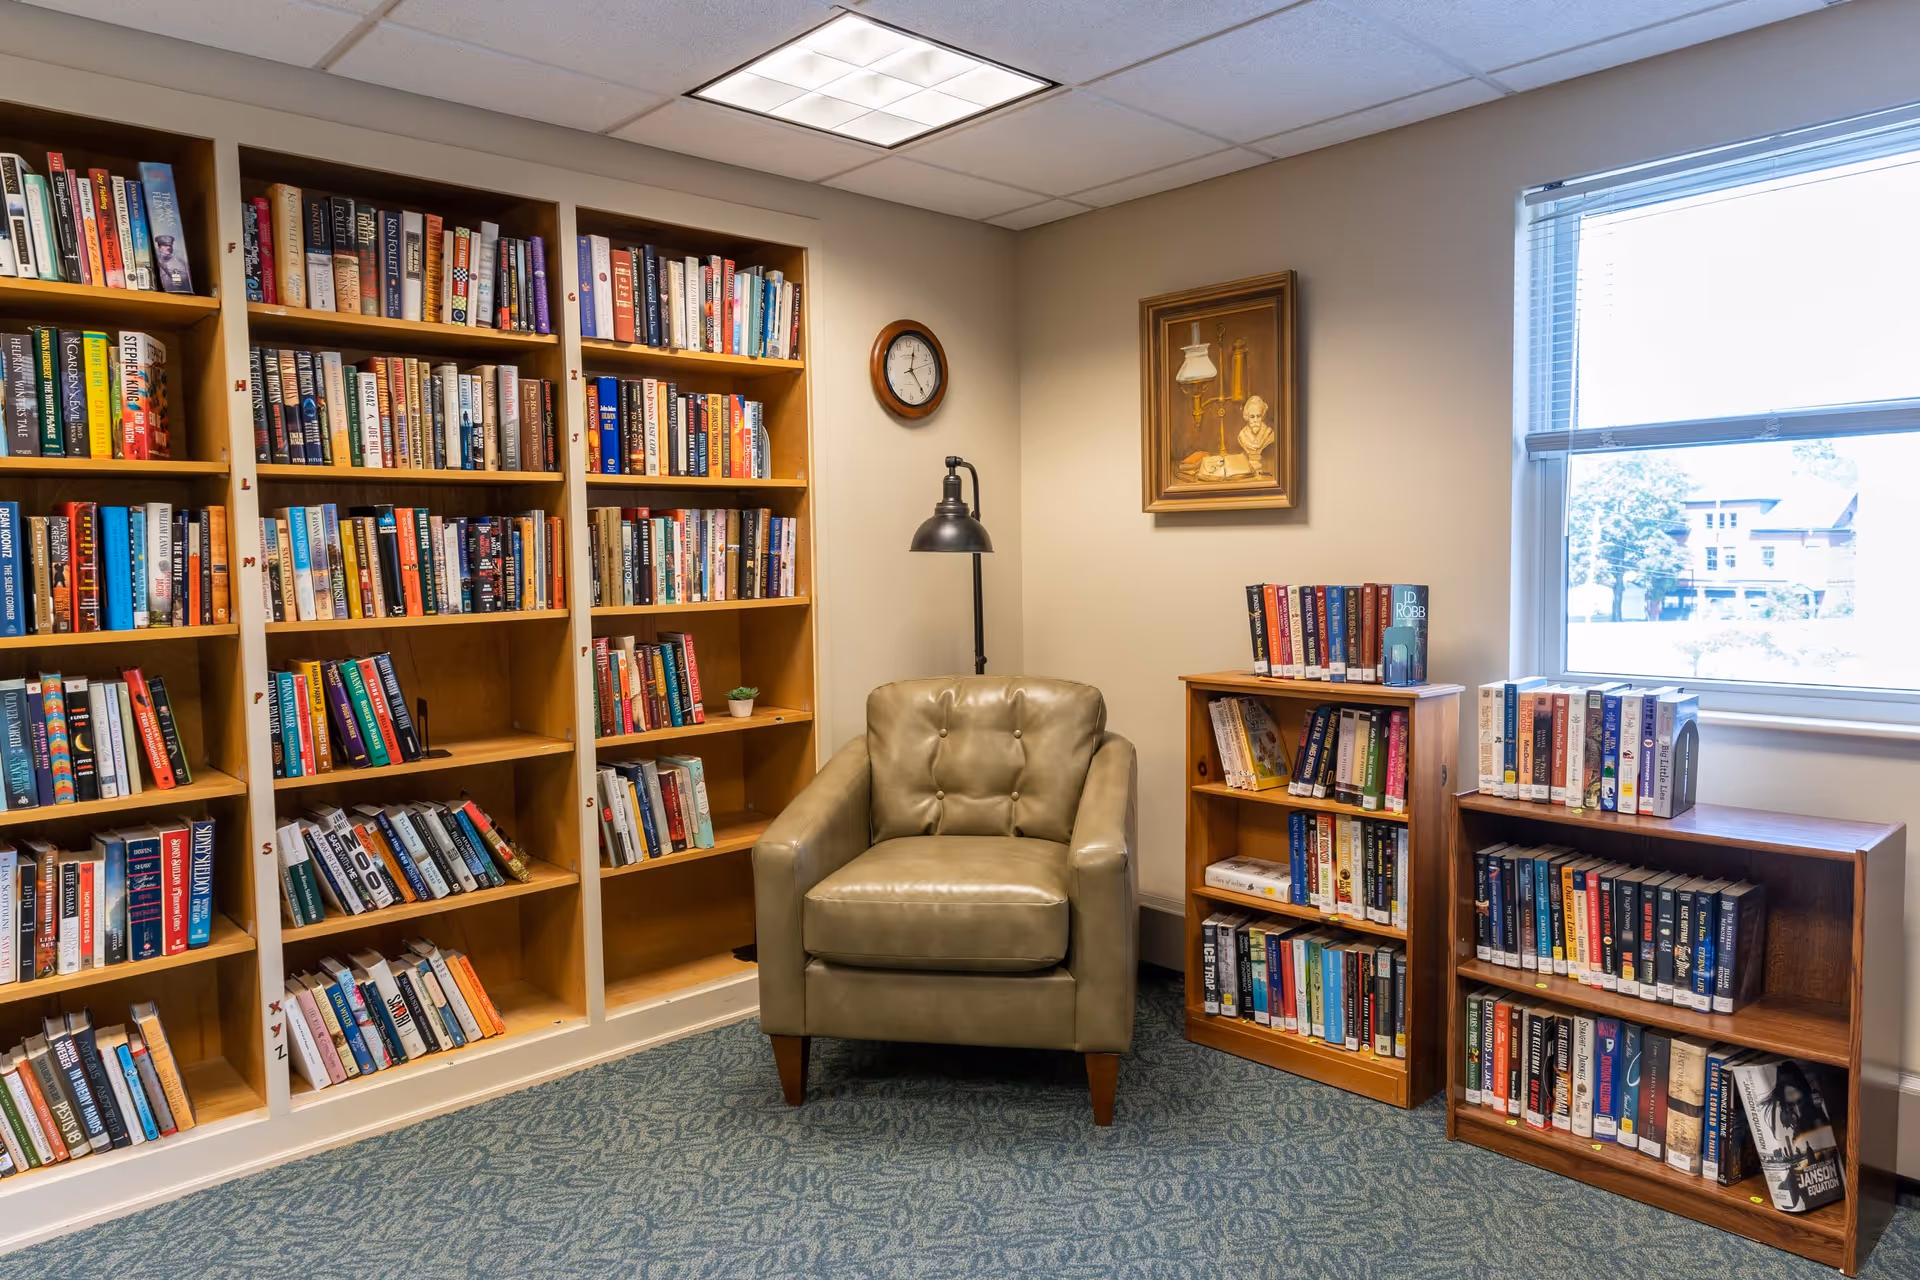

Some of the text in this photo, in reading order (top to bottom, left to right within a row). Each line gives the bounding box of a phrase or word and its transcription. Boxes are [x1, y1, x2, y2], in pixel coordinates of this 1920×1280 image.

[96, 173, 108, 210] Joy Fielding
[334, 204, 346, 245] FOLLETT
[357, 212, 370, 245] FOLLETT
[227, 242, 236, 253] F
[387, 218, 399, 275] KEN FOLLETT
[458, 238, 467, 268] FELIX FRANCIS
[338, 265, 349, 302] GIANTS
[568, 292, 576, 302] G
[40, 329, 52, 379] FRANK HERBERT
[896, 343, 902, 351] 11
[905, 340, 912, 348] 12
[924, 354, 928, 362] 2
[66, 344, 78, 388] GARDEN
[124, 335, 139, 402] STEPHEN KING
[265, 355, 281, 403] JACK HIGGINS
[297, 353, 314, 396] JACK HIGGINS
[571, 369, 578, 381] I
[927, 367, 932, 375] 3
[11, 338, 23, 373] HELPRIN
[17, 419, 28, 438] TALE
[235, 379, 247, 392] H
[364, 380, 375, 407] NOS4A2
[375, 361, 390, 416] TONY HILLERMAN
[69, 400, 81, 421] EVIL
[134, 412, 144, 435] END OF
[711, 397, 719, 431] IRIS JOHANSEN
[368, 425, 379, 455] JOE HILL
[572, 433, 579, 442] J
[711, 432, 719, 466] SMOKESCREEN
[241, 478, 251, 490] L
[0, 508, 13, 558] DEAN KOONTZ
[51, 525, 60, 555] KRENTZ
[419, 513, 430, 549] MIKE LUPICA
[174, 541, 183, 581] THE WHITE
[242, 556, 256, 568] M
[281, 547, 293, 606] SMALL ISLAND
[4, 565, 15, 620] THE SILENT CORNER
[333, 577, 344, 609] PURSUIT
[505, 556, 515, 601] STEVE MARTINI
[1317, 599, 1325, 614] NORA
[1396, 602, 1426, 618] ROBB
[1404, 591, 1417, 606] J.D.
[581, 646, 588, 657] P
[348, 667, 364, 696] CHANCE
[669, 667, 677, 688] PLAIN
[253, 692, 263, 705] P
[281, 679, 294, 728] DIANA PALMER
[672, 692, 681, 716] HARVEST
[5, 692, 22, 747] OLIVER NORTH
[340, 703, 357, 739] ROUGH WEATHER
[140, 713, 162, 769] PERRI O'SHAUGHNESSY
[148, 712, 167, 767] UNLUCKY-IN-LAW
[288, 731, 297, 766] UNLEASHED
[9, 757, 24, 794] SANCTION
[1304, 743, 1318, 779] JAMES PATTERSON
[1659, 745, 1668, 800] Big Little Lies
[586, 797, 594, 808] S
[171, 838, 181, 885] SIDNEY SHELDON
[193, 824, 212, 895] SIDNEY SHELDON
[261, 842, 273, 855] S
[328, 834, 358, 880] SAFE WITH ME
[341, 829, 381, 890] MOO
[463, 840, 479, 863] FOUNTAIN
[427, 861, 442, 884] NICHOLAS
[65, 871, 74, 916] JEFF SHAARA
[1565, 886, 1573, 901] Out
[1566, 902, 1571, 913] on
[1567, 921, 1575, 943] Limb
[1680, 906, 1689, 943] ALICE HOFFMAN
[1204, 943, 1216, 991] ICE TRAP
[268, 1000, 282, 1015] X
[333, 992, 353, 1028] LORI WILDE
[386, 994, 411, 1028] SATORI
[402, 977, 421, 1013] ISLAND JUSTICE
[271, 1023, 282, 1038] Y
[1558, 1024, 1568, 1071] FAYE KELLERMAN
[53, 1041, 72, 1070] WEBER
[63, 1039, 79, 1063] DAVID
[274, 1044, 287, 1060] Z
[1530, 1021, 1541, 1113] FAYE KELLERMAN GUN GAMES
[1577, 1020, 1589, 1080] STRAIGHT DARKNESS
[38, 1059, 53, 1084] SHARON
[46, 1084, 61, 1102] WEBB
[78, 1040, 121, 1133] ARTEMIS ANDY WEIR
[1600, 1054, 1612, 1113] JONATHAN KELLERMAN
[1676, 1048, 1686, 1094] HISTORIAN
[1710, 1062, 1719, 1091] ELMORE
[69, 1068, 103, 1134] IN ENEMY HANDS
[1555, 1076, 1567, 1113] HANGMAN
[1709, 1093, 1718, 1126] LEONARD
[1720, 1085, 1728, 1113] WRINKLE
[52, 1100, 82, 1143] PESTIS 18
[1742, 1081, 1767, 1150] JANSON EQUATION
[1798, 1164, 1838, 1189] JANSON
[1808, 1177, 1840, 1196] EQUATION
